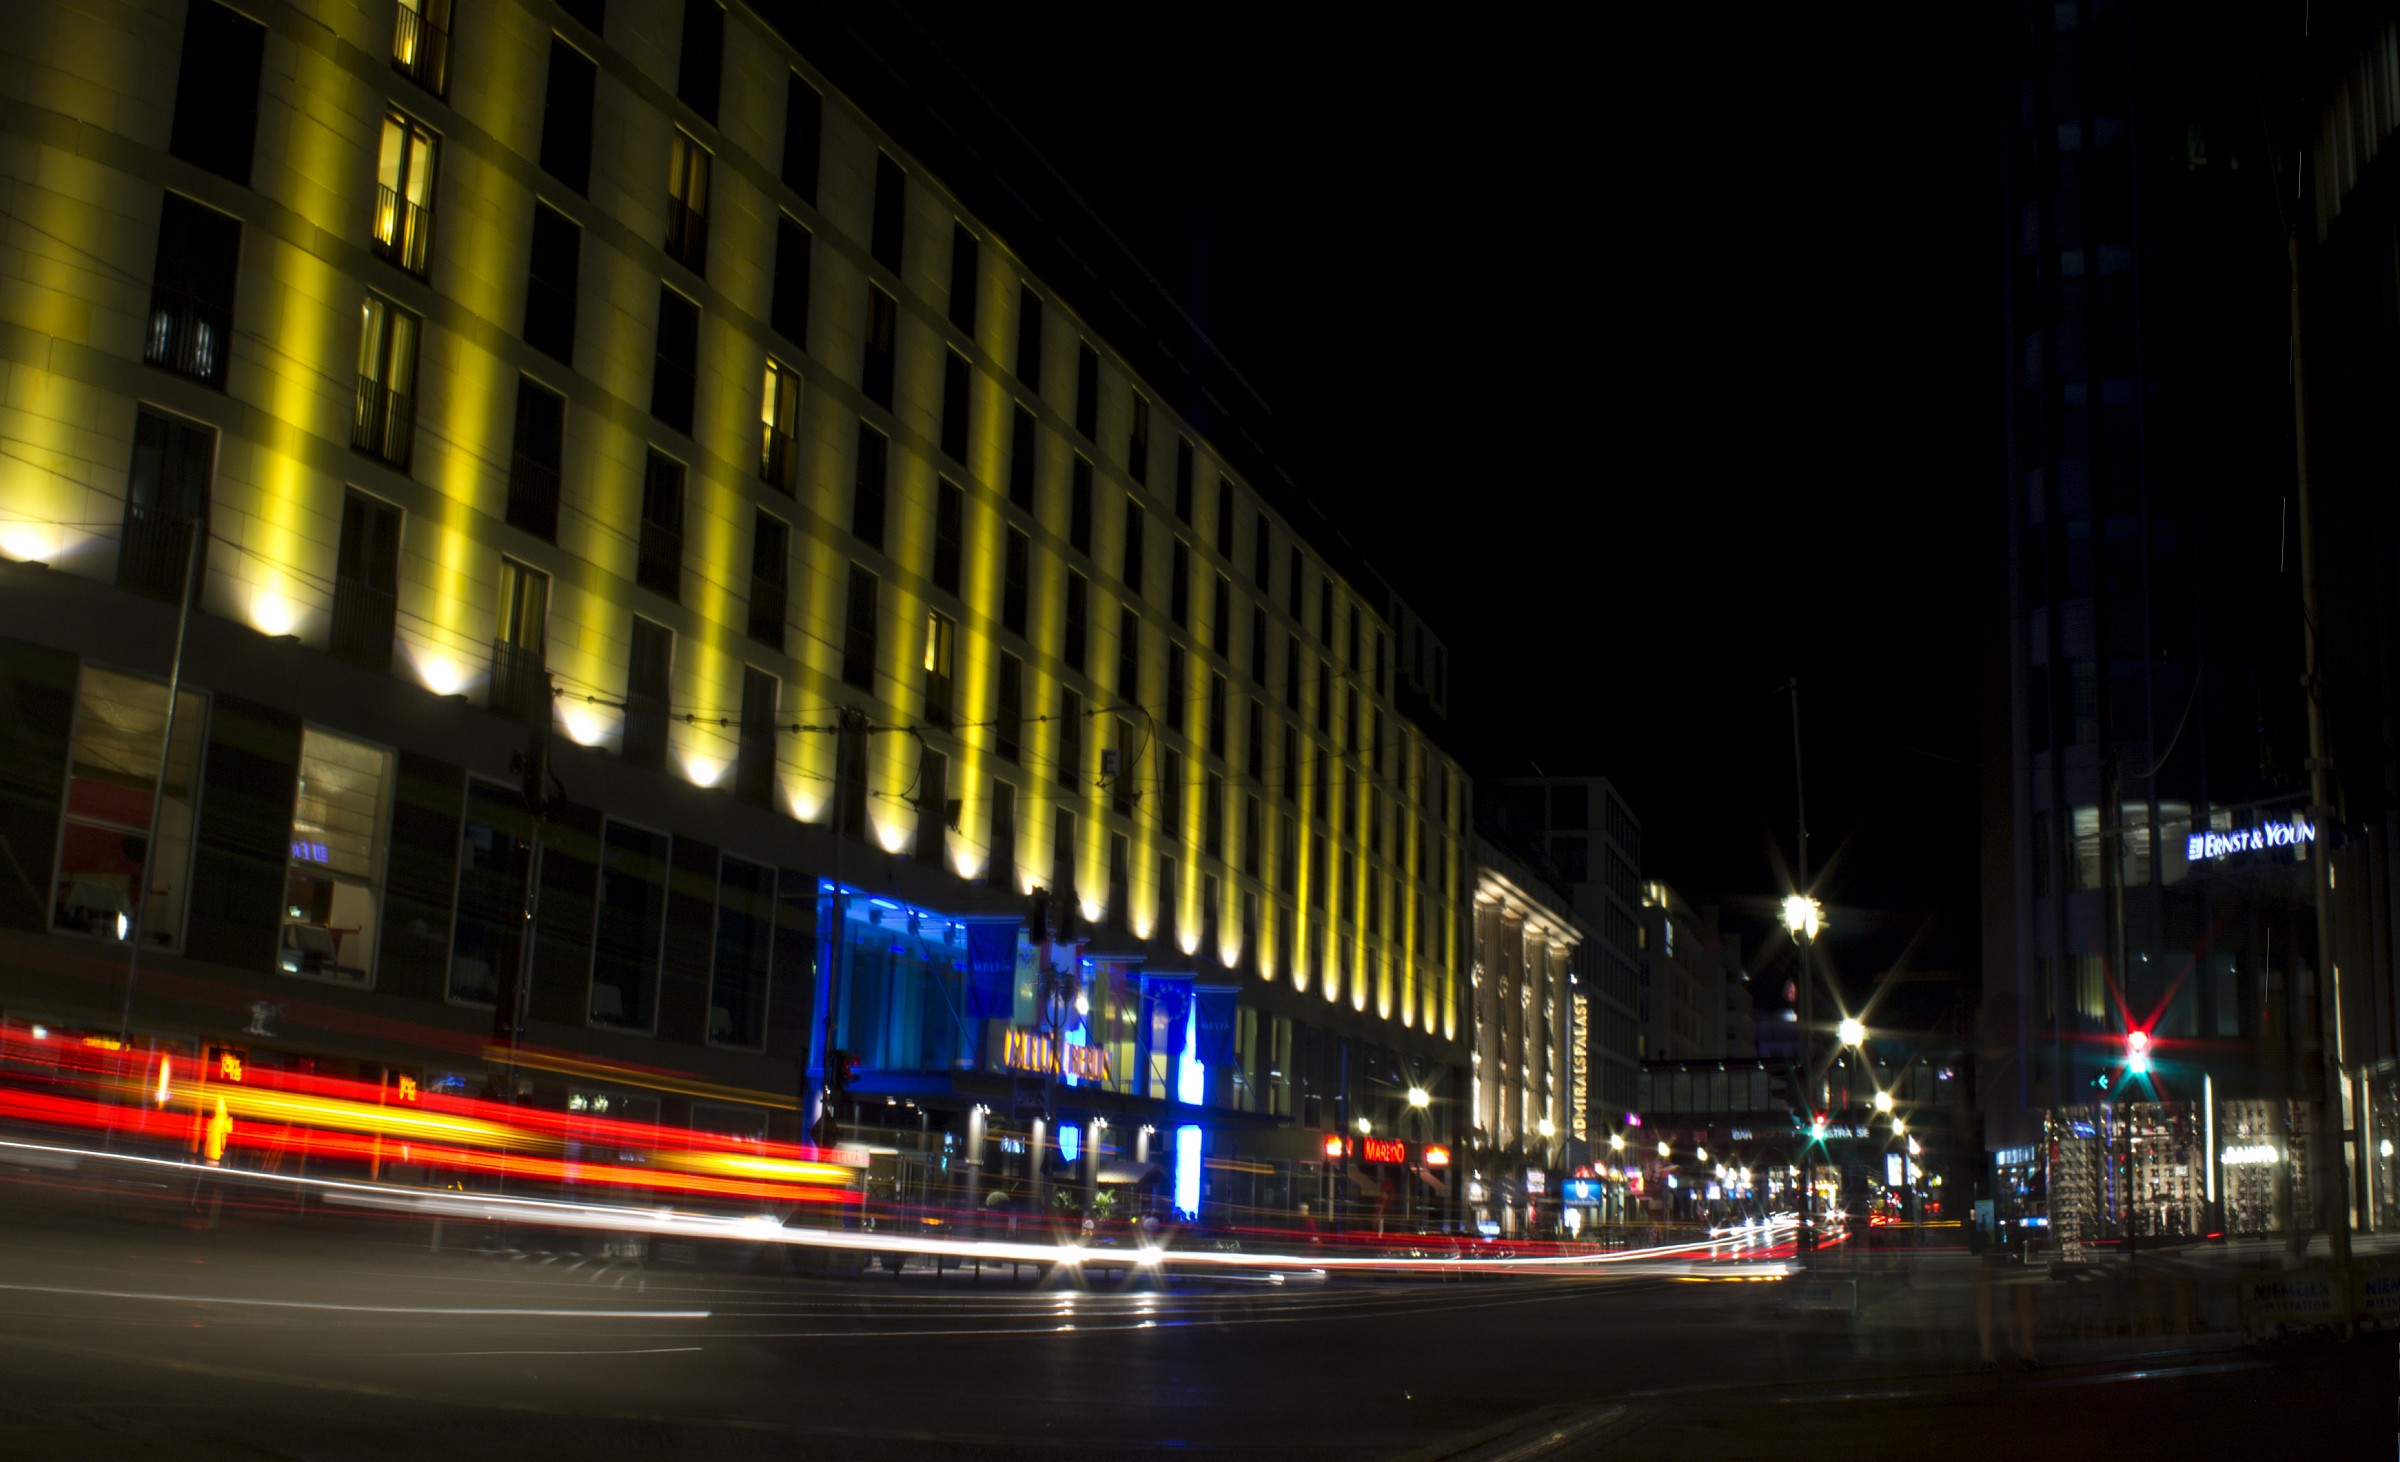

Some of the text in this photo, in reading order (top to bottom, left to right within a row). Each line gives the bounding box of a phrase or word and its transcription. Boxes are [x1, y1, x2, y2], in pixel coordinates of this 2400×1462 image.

[2204, 829, 2250, 858] ERNST
[2250, 826, 2264, 850] &
[2264, 820, 2316, 847] YOUN
[1063, 1041, 1112, 1081] BERLIN
[1573, 993, 1588, 1142] ADMIRALSPALAST
[1364, 1136, 1406, 1164] MAREDO
